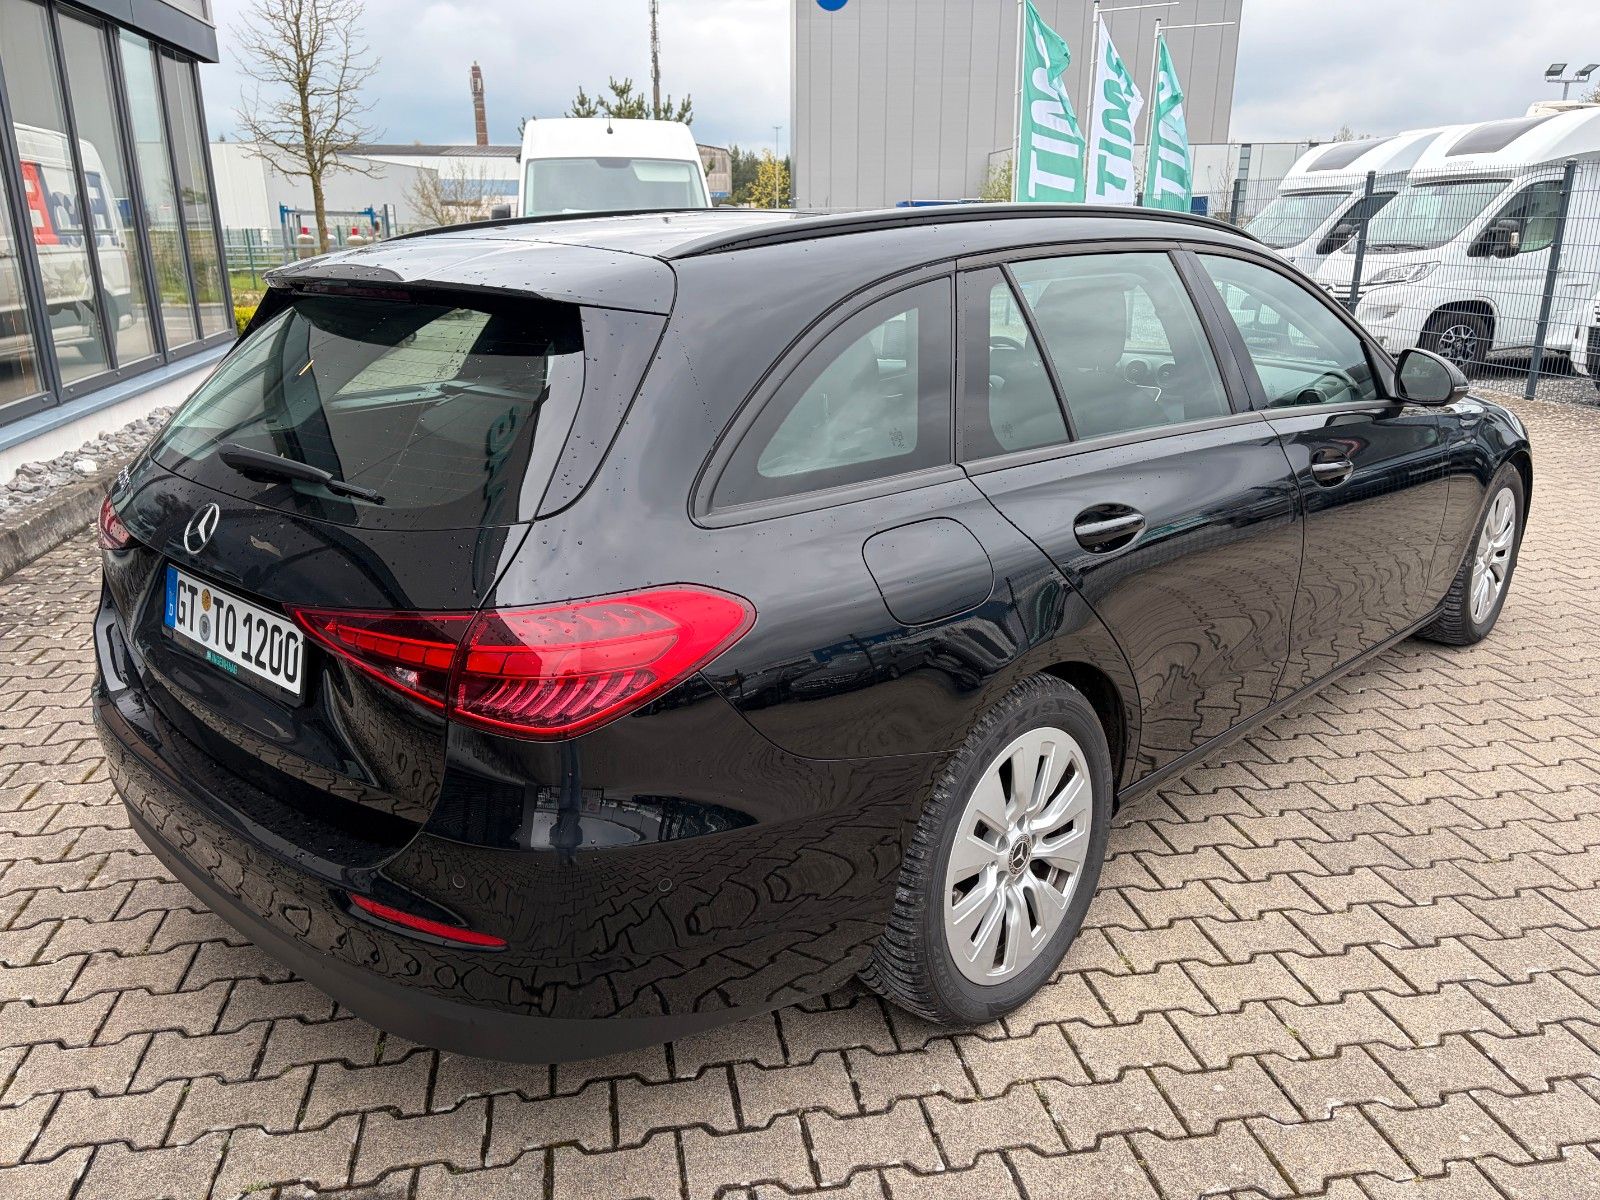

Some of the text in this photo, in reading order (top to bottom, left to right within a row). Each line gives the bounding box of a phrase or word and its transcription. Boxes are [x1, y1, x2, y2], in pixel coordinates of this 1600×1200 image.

[176, 579, 300, 684] GT TO 1200
